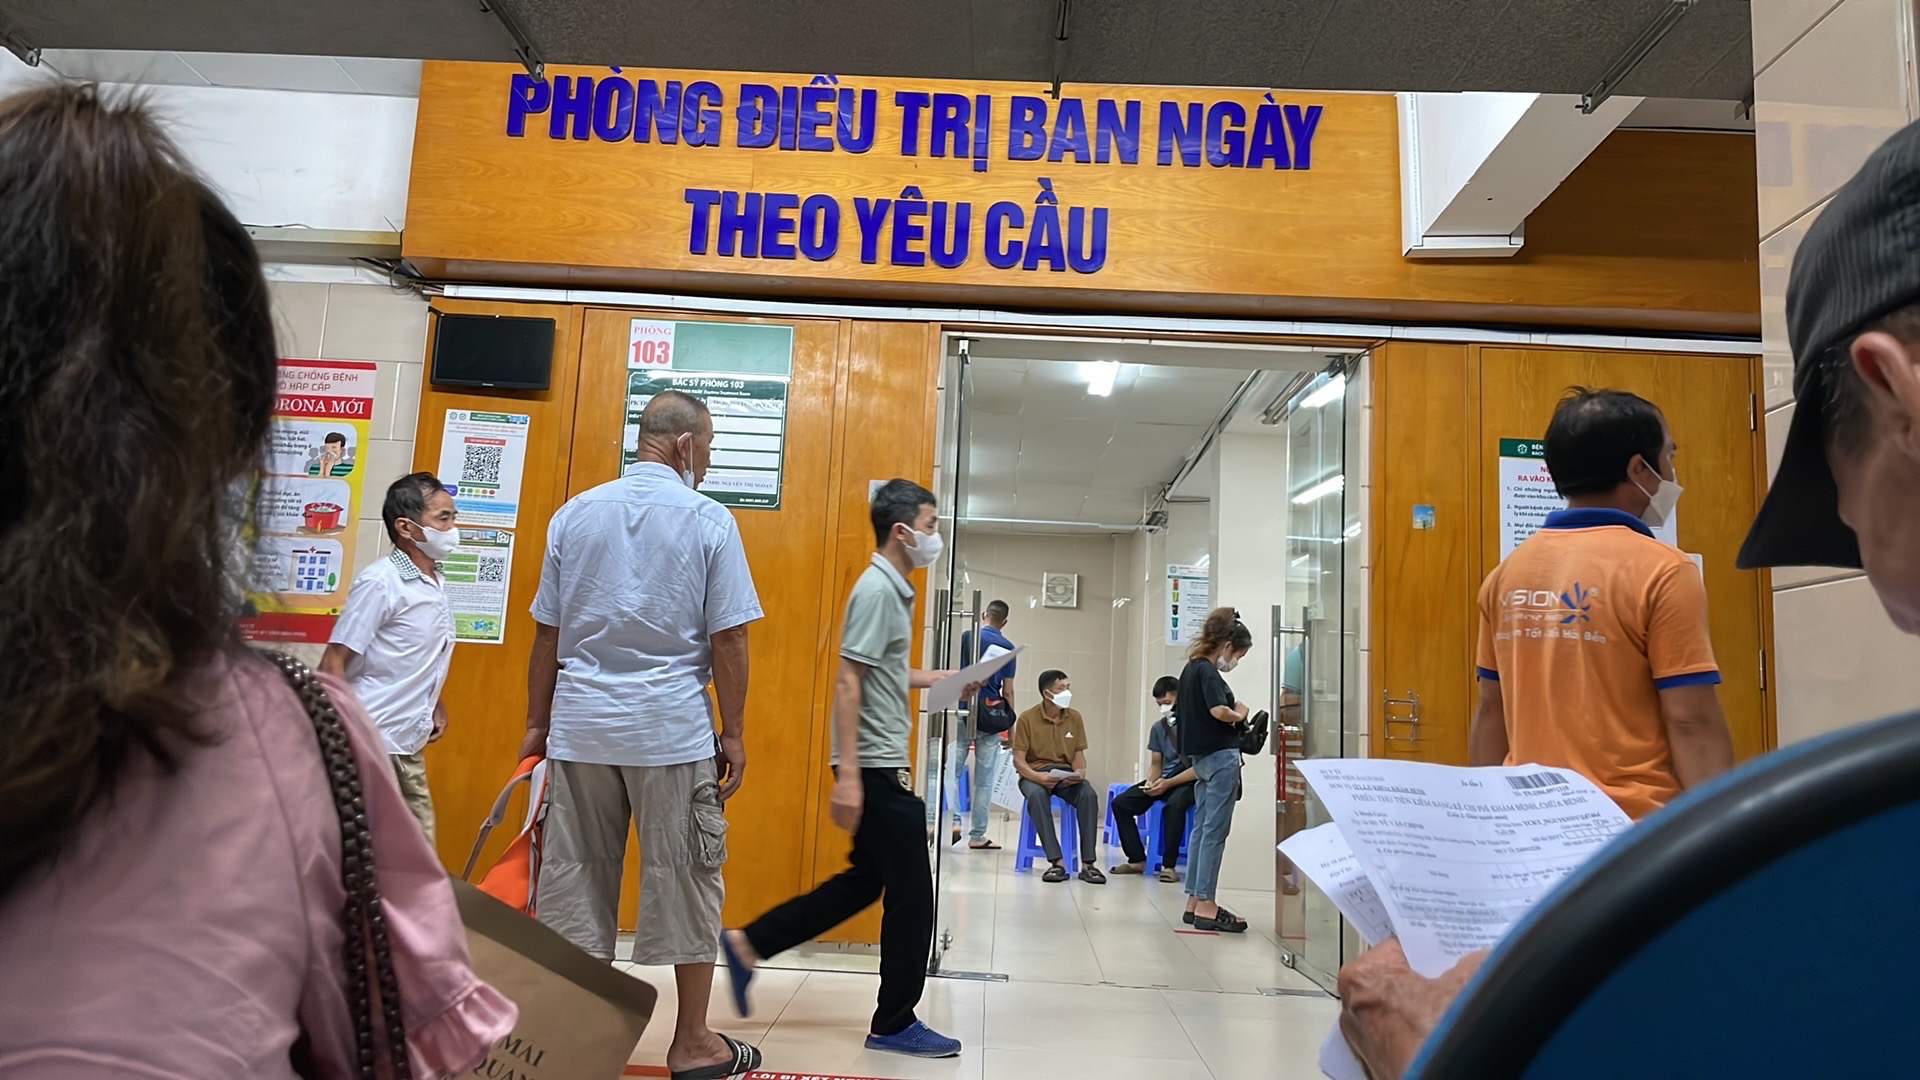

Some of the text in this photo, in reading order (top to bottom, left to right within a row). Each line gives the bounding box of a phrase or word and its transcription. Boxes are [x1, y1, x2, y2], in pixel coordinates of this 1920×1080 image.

[506, 66, 1323, 172] PHÒNG ĐIỀU TRỊ BAN NGÀY
[685, 177, 1108, 274] THEO YÊU CẦU
[634, 325, 672, 335] PHÒNG
[632, 340, 670, 364] 103
[298, 371, 330, 380] CHỐNG
[332, 372, 358, 382] BỆNH
[700, 378, 729, 388] PHÒNG
[730, 380, 744, 388] 103
[330, 397, 366, 414] MỚI
[1529, 474, 1545, 482] VÀO
[1500, 589, 1562, 606] VISION
[499, 1033, 545, 1067] MAI
